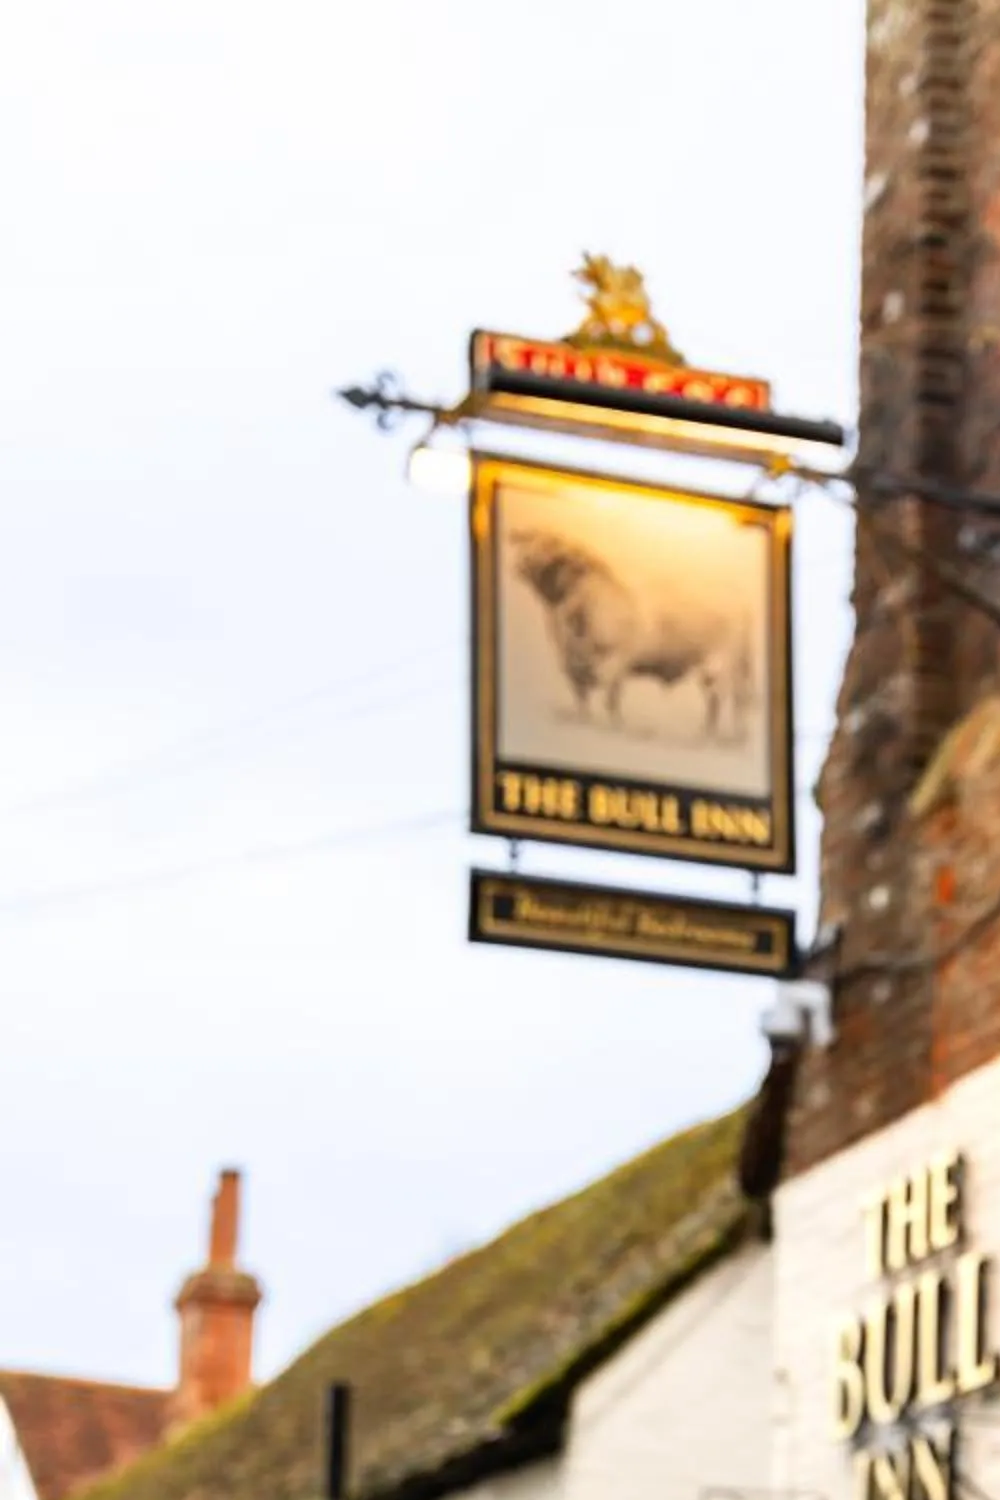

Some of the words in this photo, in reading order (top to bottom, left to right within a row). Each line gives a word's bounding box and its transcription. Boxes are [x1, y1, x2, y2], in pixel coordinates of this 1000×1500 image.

[501, 771, 577, 821] THE
[588, 784, 681, 835] BULL
[690, 798, 771, 845] INN
[864, 1147, 965, 1282] THE
[830, 1249, 1000, 1444] BULL
